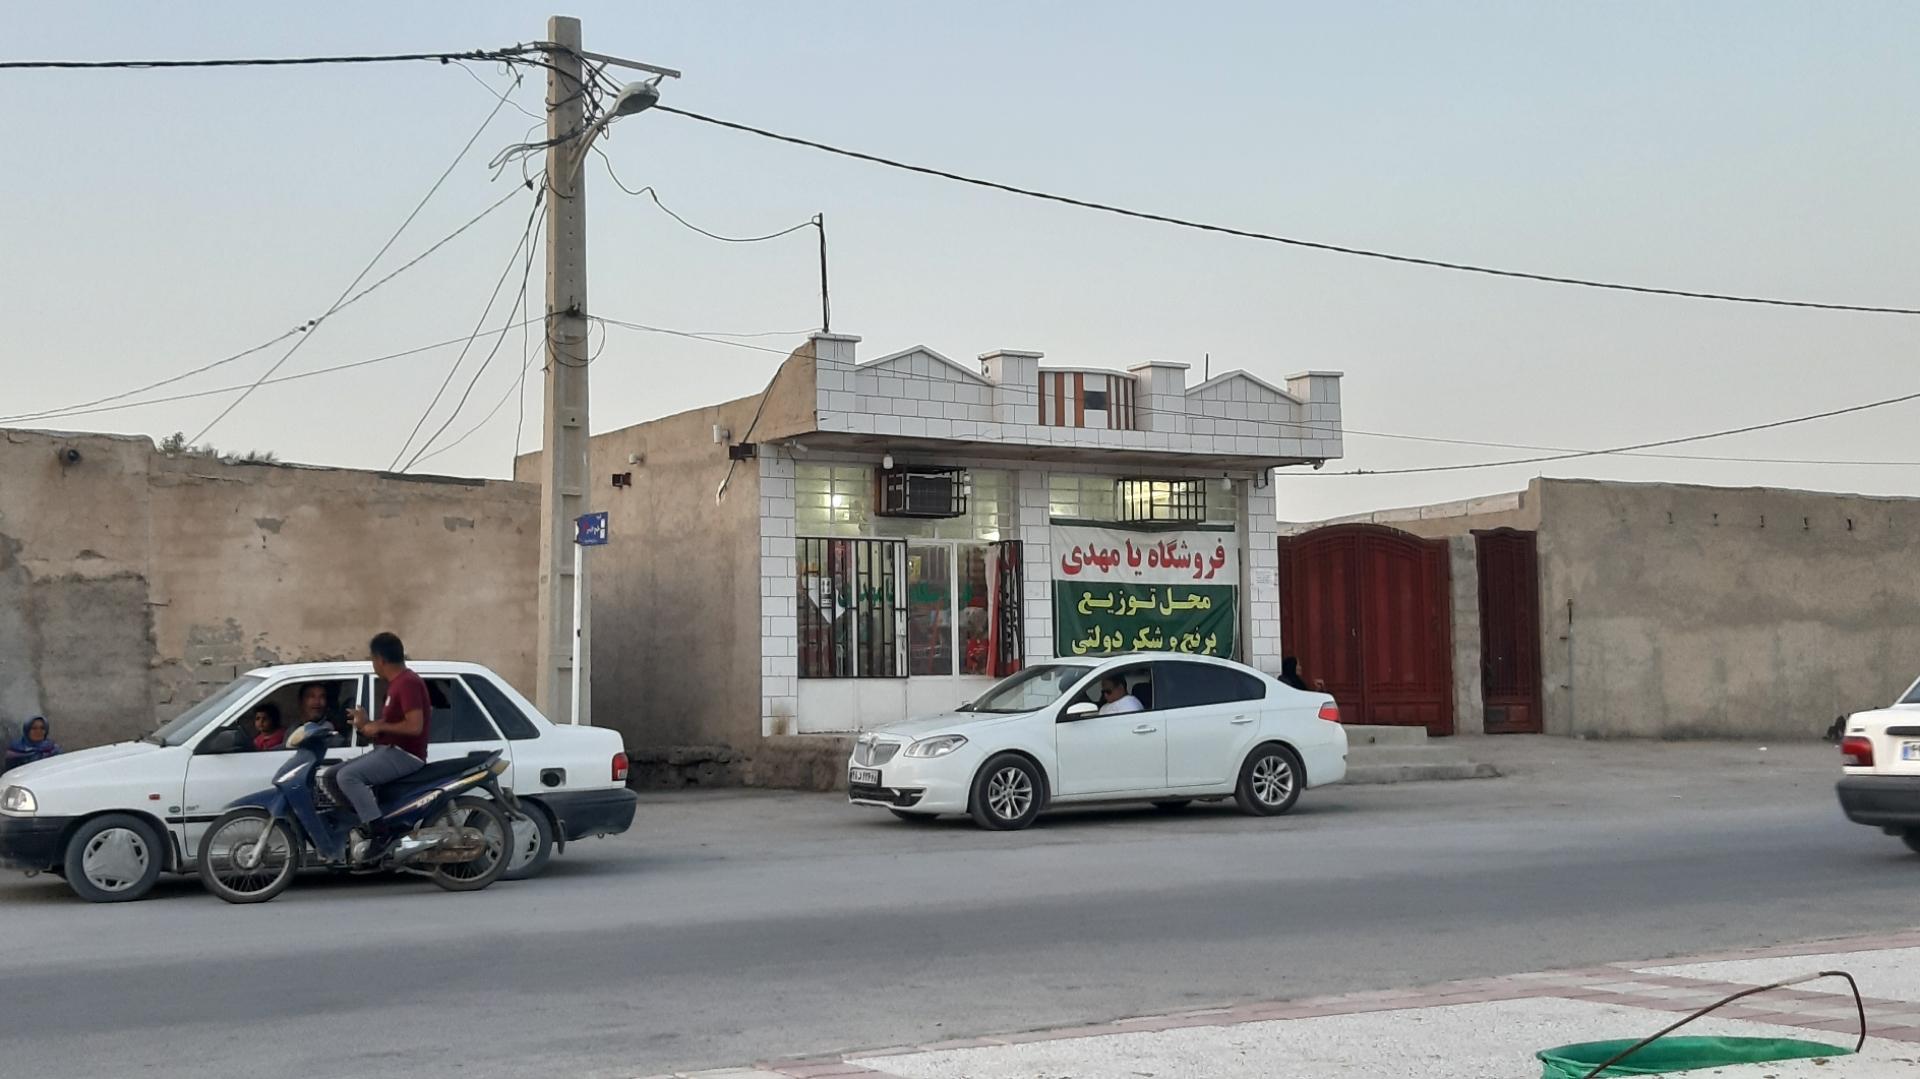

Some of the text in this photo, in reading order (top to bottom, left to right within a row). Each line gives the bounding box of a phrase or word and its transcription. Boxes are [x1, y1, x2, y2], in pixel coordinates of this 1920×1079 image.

[1061, 537, 1226, 579] فروشگاه یا مهدی
[1077, 587, 1211, 615] محل توزیع
[1071, 625, 1217, 655] برنج و شکر دولتی
